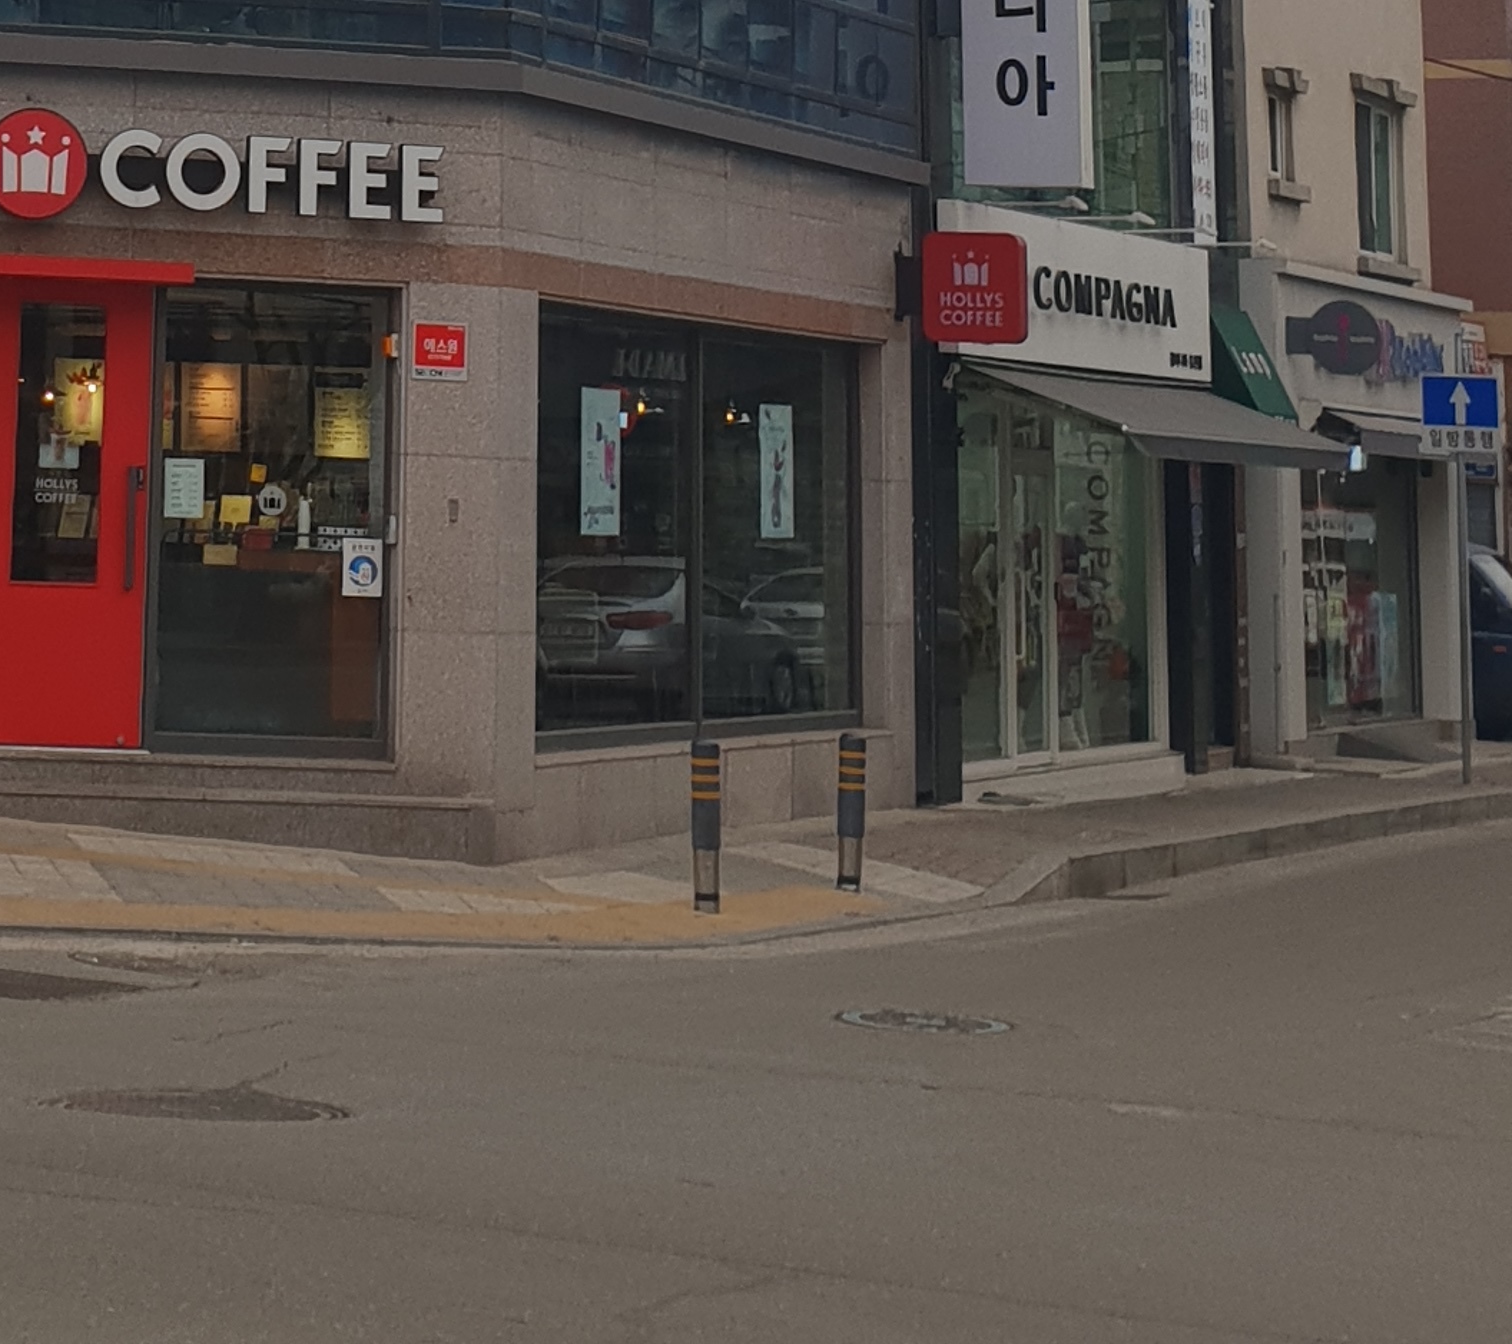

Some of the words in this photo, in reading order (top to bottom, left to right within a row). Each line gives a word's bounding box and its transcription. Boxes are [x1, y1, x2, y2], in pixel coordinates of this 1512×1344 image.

[99, 128, 445, 224] COFFEE
[940, 291, 1005, 309] HOLLYS
[1033, 265, 1178, 329] COMPAGNA
[940, 310, 1004, 327] COFFEE
[35, 477, 79, 490] HOLLYS
[34, 492, 78, 505] COFFEE
